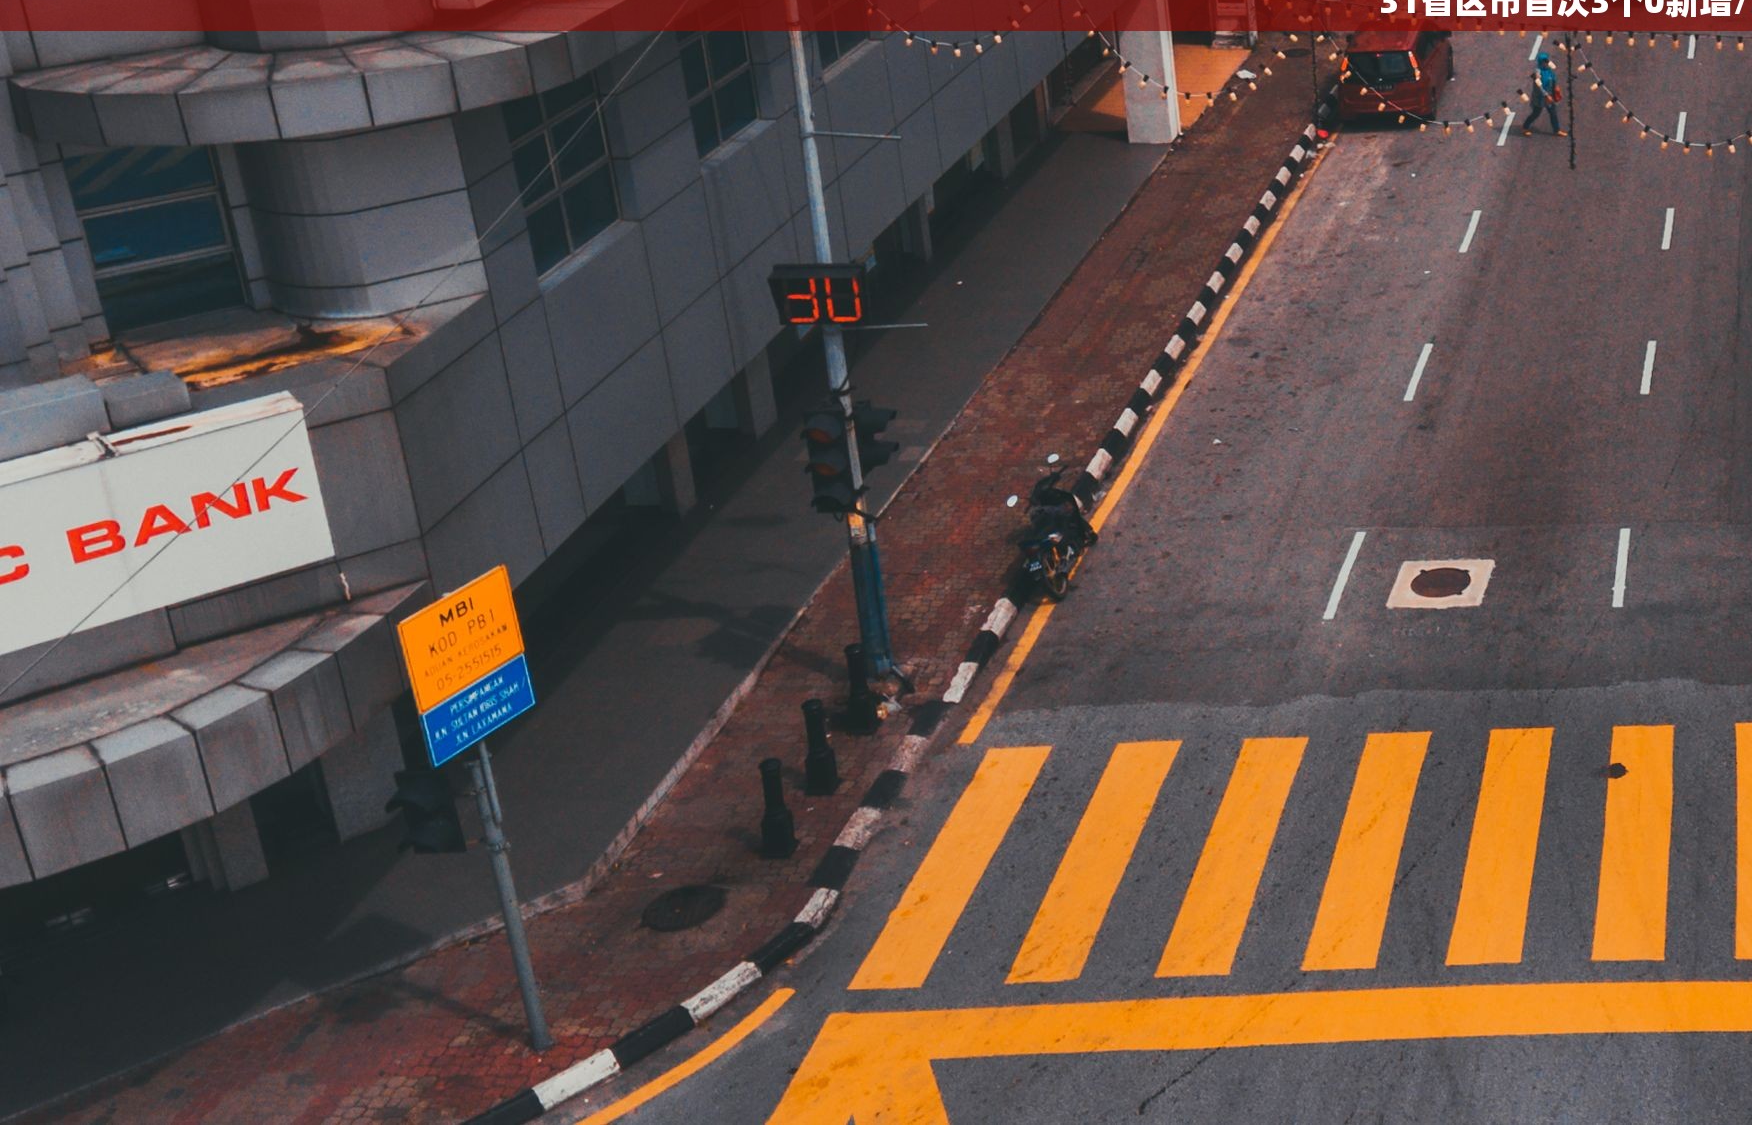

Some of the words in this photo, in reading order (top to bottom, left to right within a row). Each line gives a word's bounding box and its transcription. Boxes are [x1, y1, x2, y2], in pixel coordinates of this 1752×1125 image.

[66, 467, 309, 565] BANK
[439, 597, 475, 627] MBI
[429, 631, 458, 658] KOD
